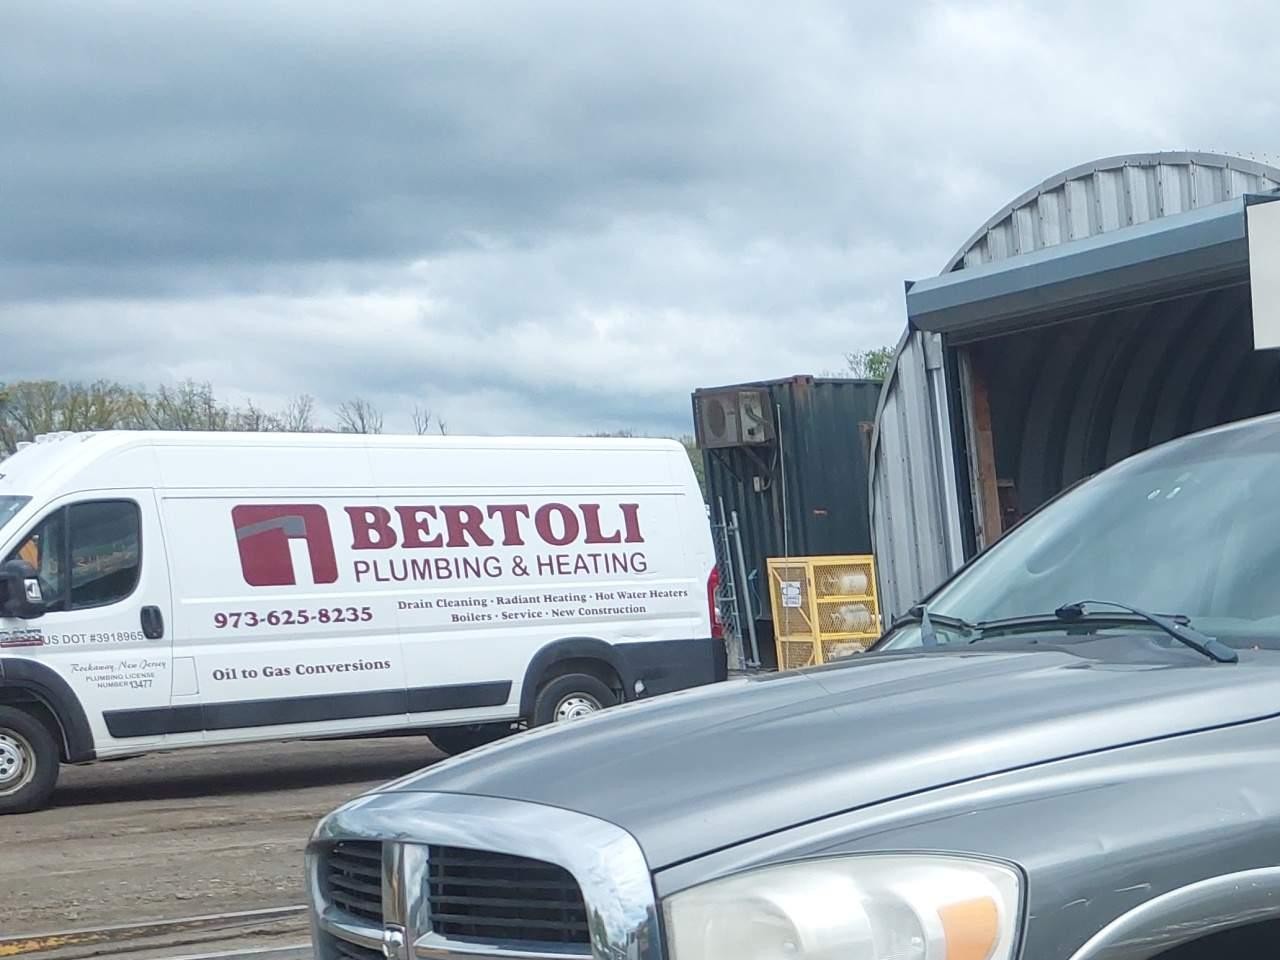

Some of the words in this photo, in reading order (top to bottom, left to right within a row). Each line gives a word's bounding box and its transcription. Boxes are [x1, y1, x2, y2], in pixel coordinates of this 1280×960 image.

[344, 502, 645, 549] BERTOLI
[353, 555, 502, 583] PLUMBING
[511, 555, 530, 577] &
[537, 552, 648, 576] HEATING
[397, 600, 433, 610] Drain
[436, 597, 488, 608] Cleaning
[496, 595, 541, 606] Radiant
[543, 592, 588, 603] Heating
[595, 592, 614, 601] Hot
[616, 591, 647, 600] Water
[649, 589, 688, 599] Heaters
[213, 606, 373, 629] 973-625-8235
[451, 612, 493, 623] Boilers
[501, 609, 543, 620] Service
[551, 608, 575, 618] New
[578, 604, 647, 616] Construction
[63, 633, 87, 645] DOT
[90, 631, 144, 643] #3918965
[119, 661, 138, 670] New
[139, 659, 167, 670] Jersey
[213, 668, 237, 681] Oil
[242, 667, 258, 679] to
[262, 666, 291, 678] Gas
[295, 659, 391, 676] Conversions
[86, 674, 124, 682] PLUMBING
[125, 672, 155, 680] LICENSE
[97, 681, 128, 689] NUMBER
